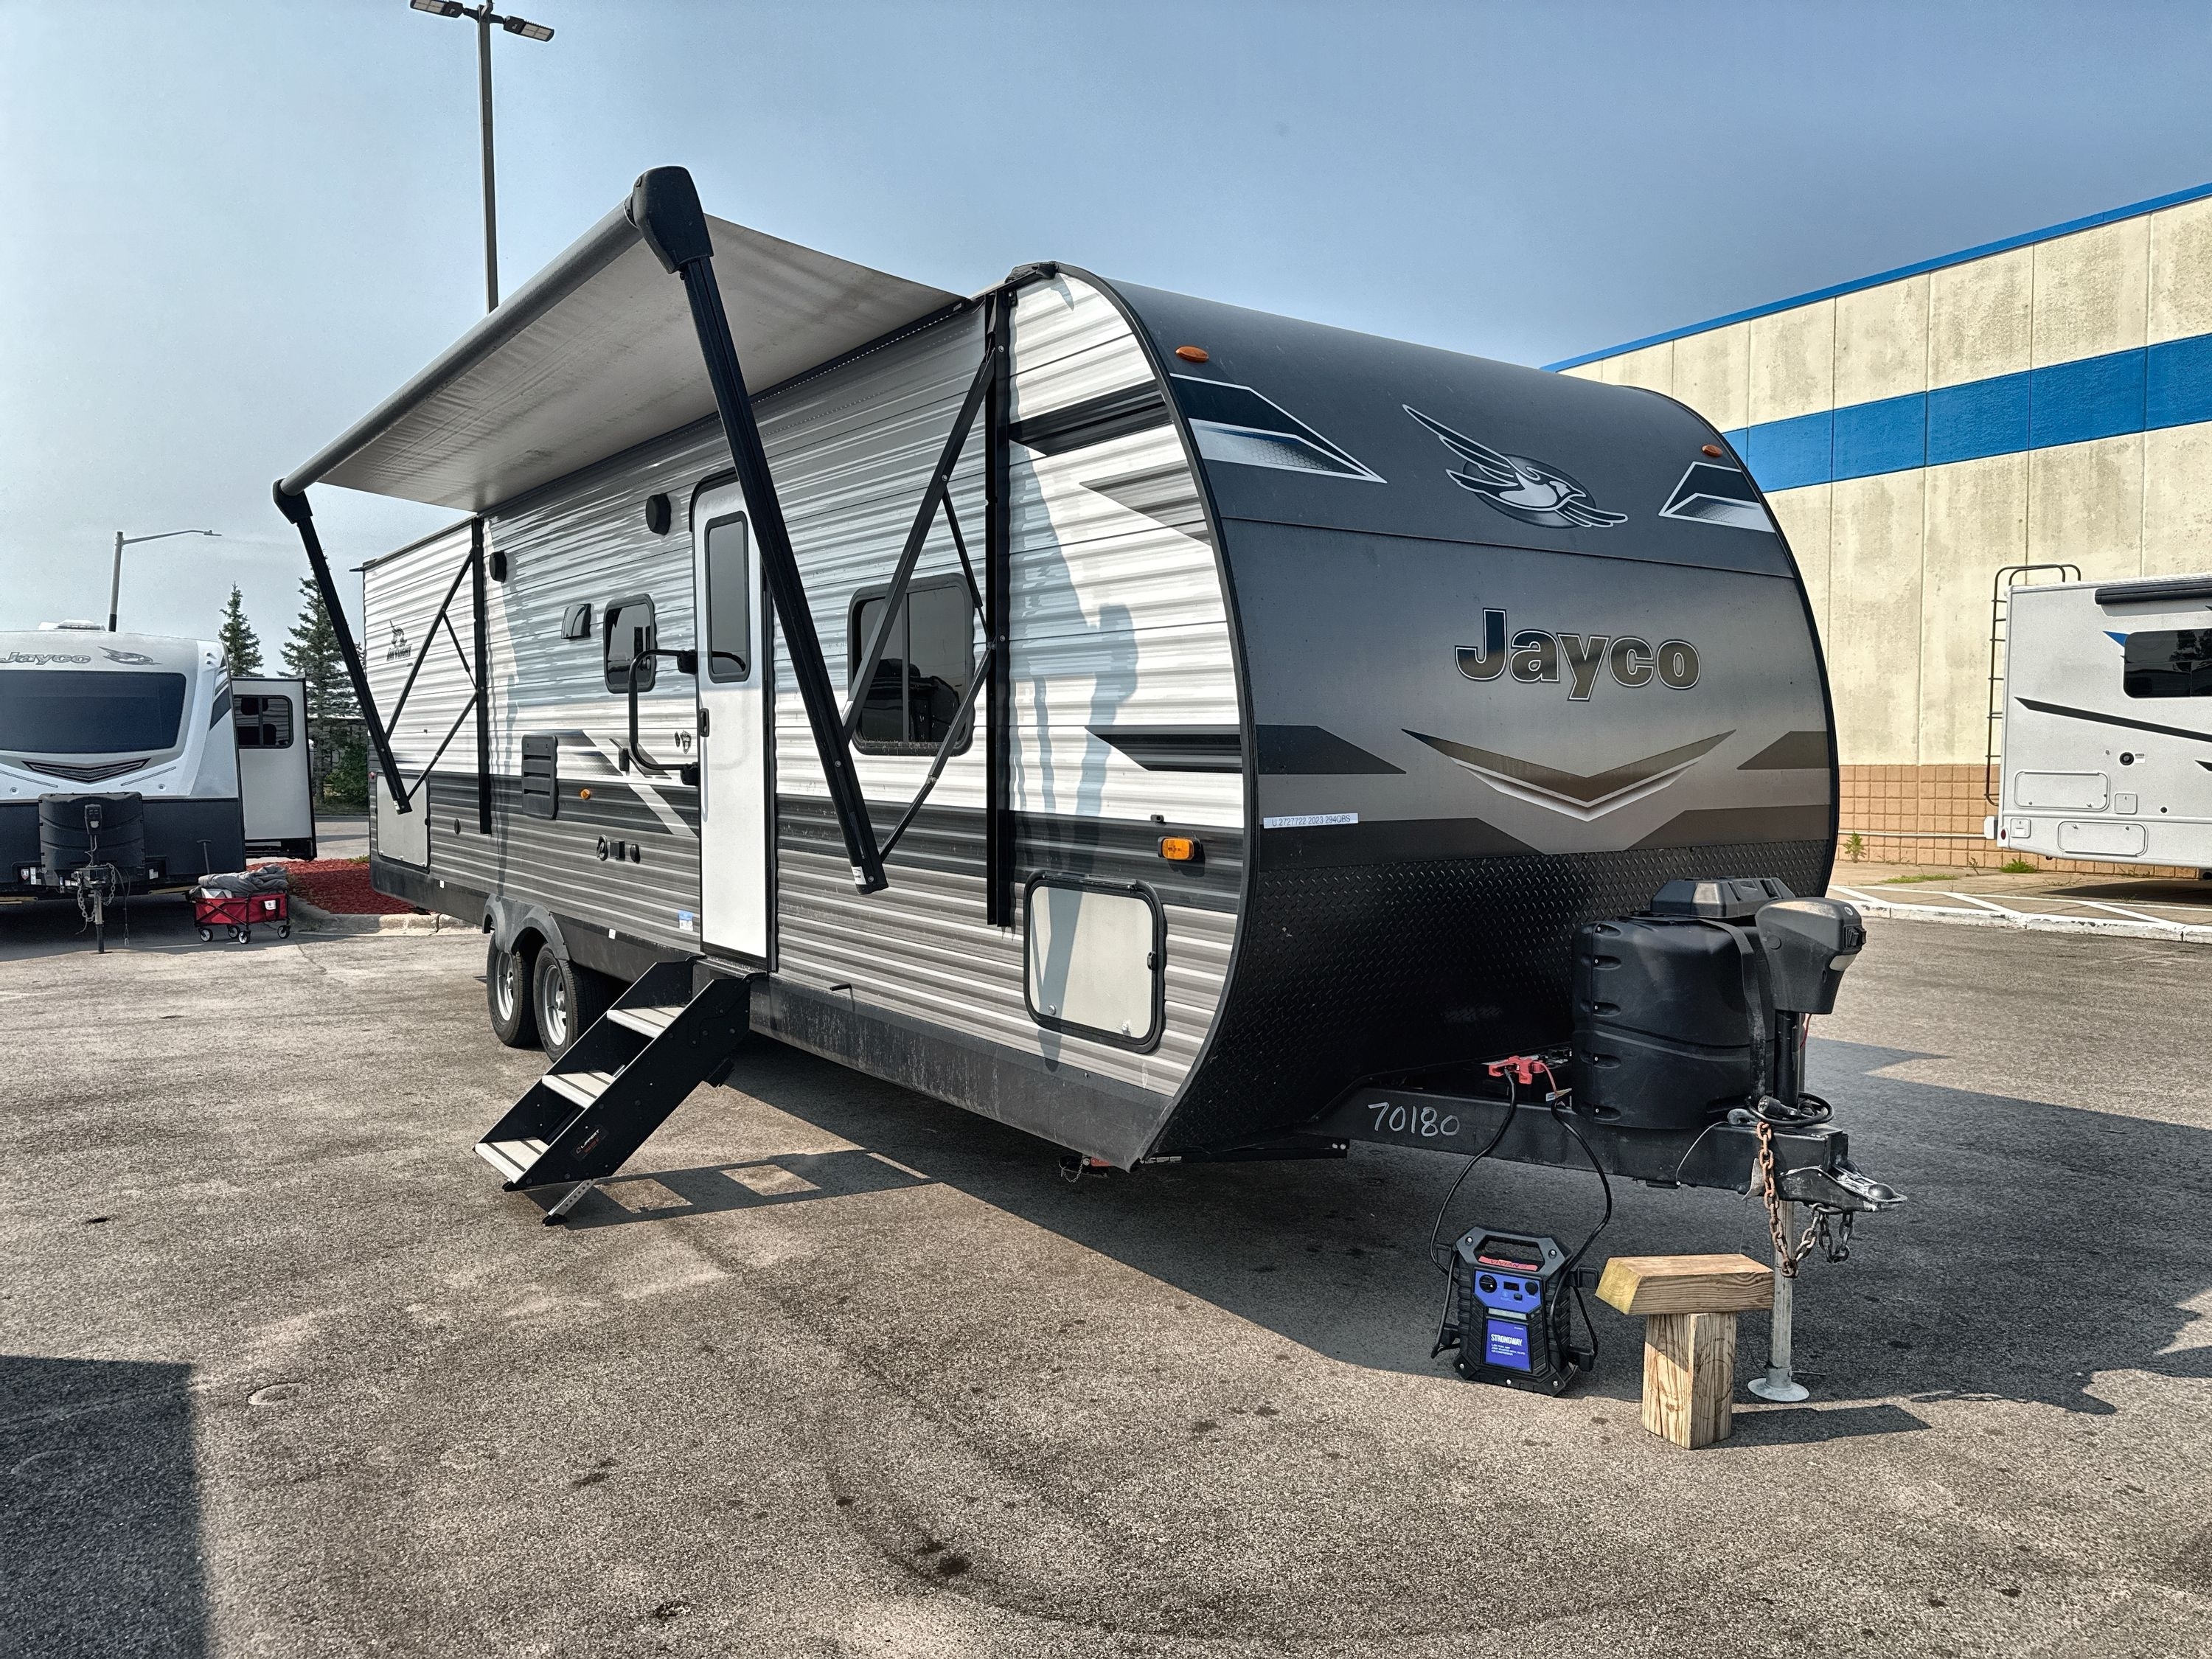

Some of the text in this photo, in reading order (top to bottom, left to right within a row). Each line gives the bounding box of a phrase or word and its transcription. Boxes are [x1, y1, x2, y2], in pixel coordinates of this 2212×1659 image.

[0, 651, 91, 665] Jayco
[1455, 608, 1701, 702] Jayco
[1279, 818, 1307, 827] 2727722
[1308, 816, 1324, 825] 2023
[1325, 815, 1351, 824] 294QBS
[1368, 1102, 1460, 1137] 70180
[1490, 1259, 1520, 1268] VIVIAN
[1491, 1334, 1523, 1346] STRONGWAY
